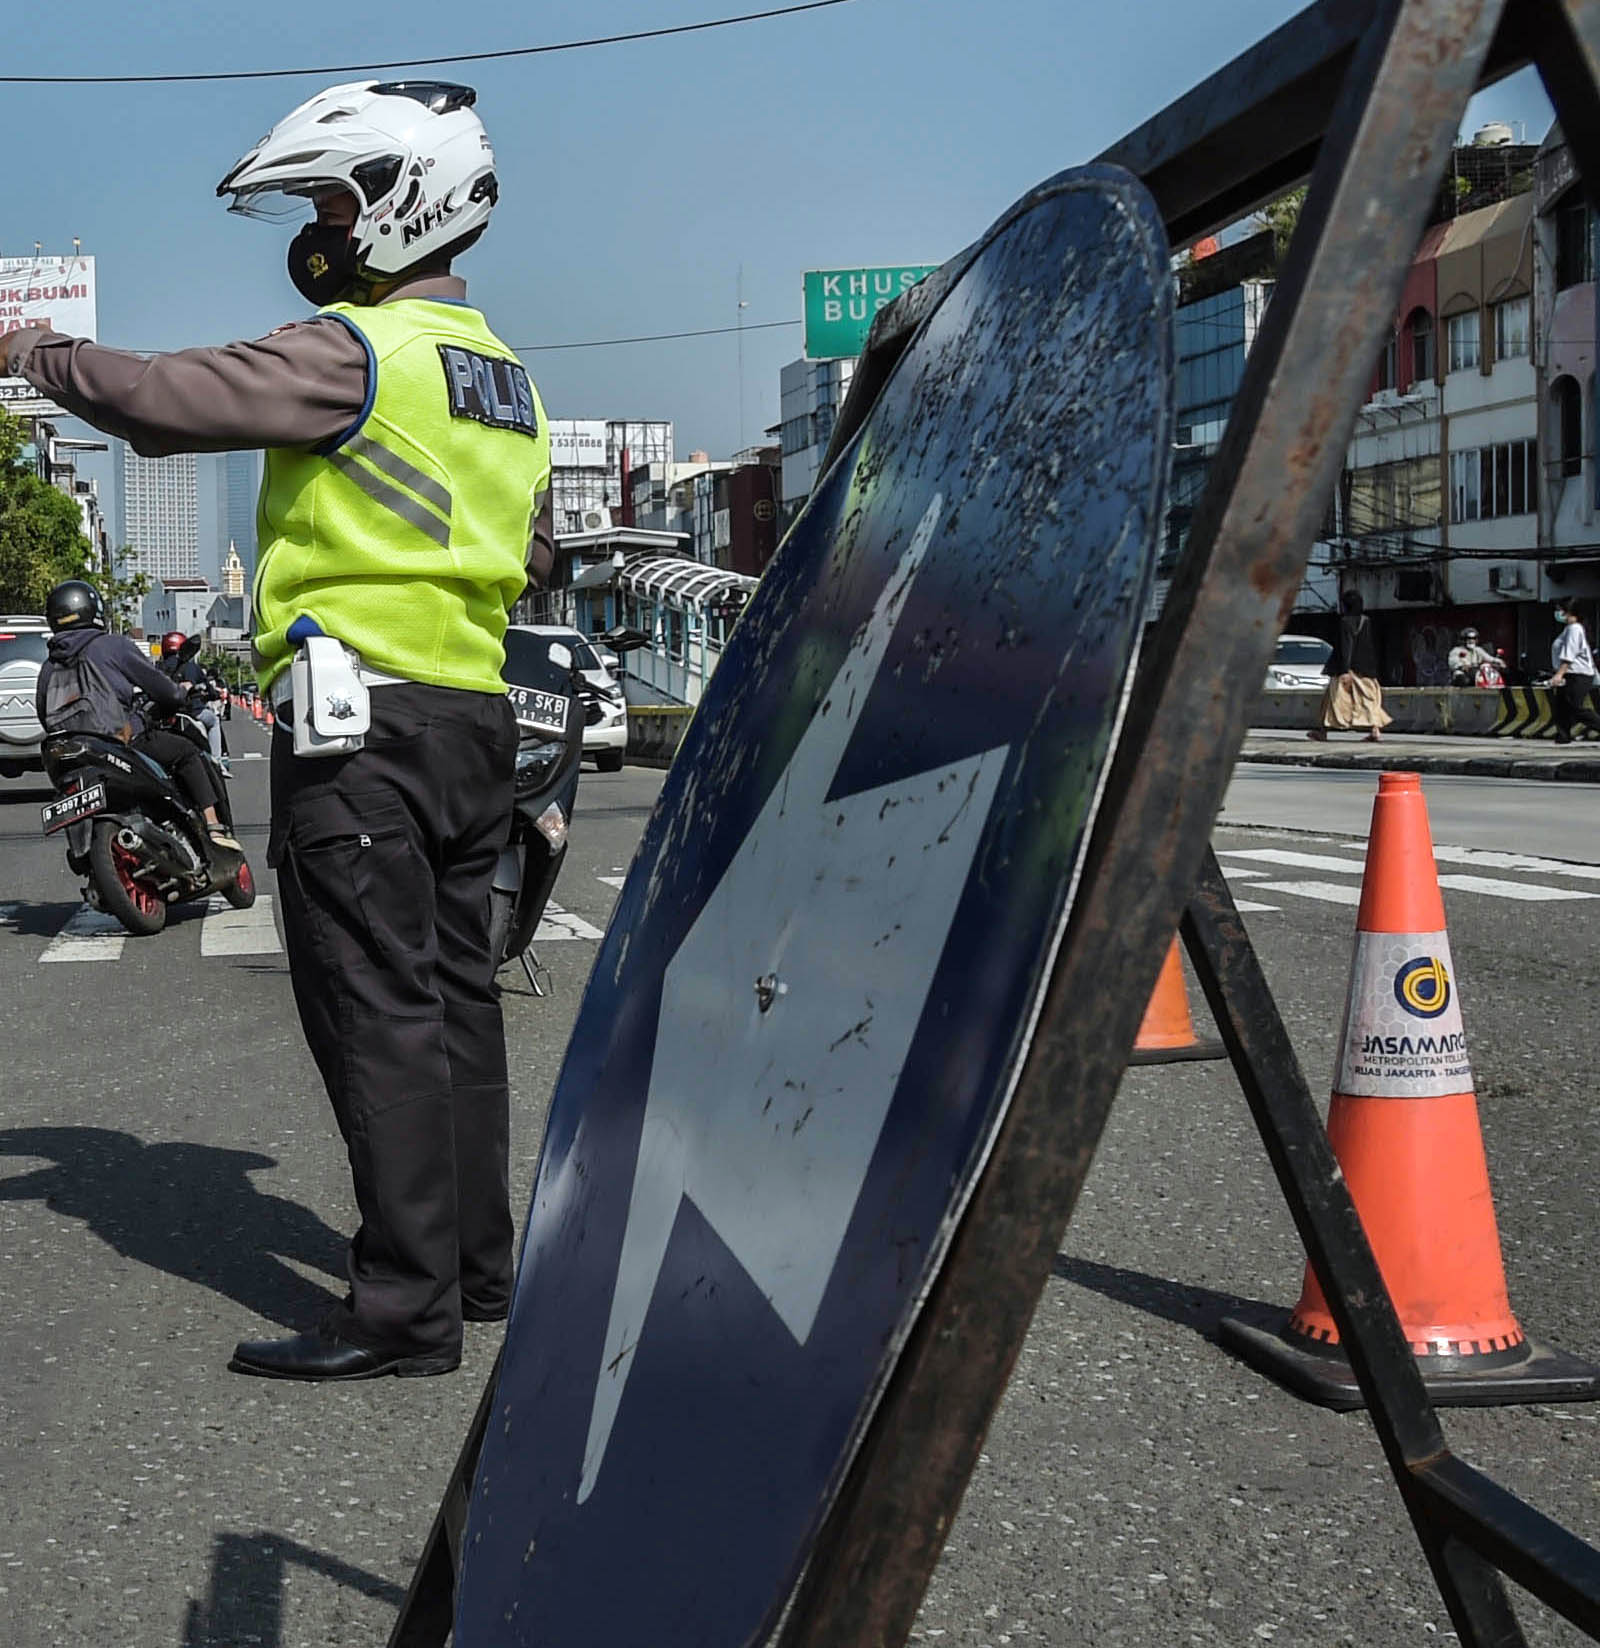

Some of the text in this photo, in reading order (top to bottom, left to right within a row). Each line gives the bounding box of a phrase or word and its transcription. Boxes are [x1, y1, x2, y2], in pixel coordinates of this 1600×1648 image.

[27, 284, 87, 300] BUMI
[823, 271, 928, 297] KHUS
[446, 348, 537, 430] POLIS
[535, 695, 563, 713] SKB
[1385, 1068, 1436, 1079] JAKARTA
